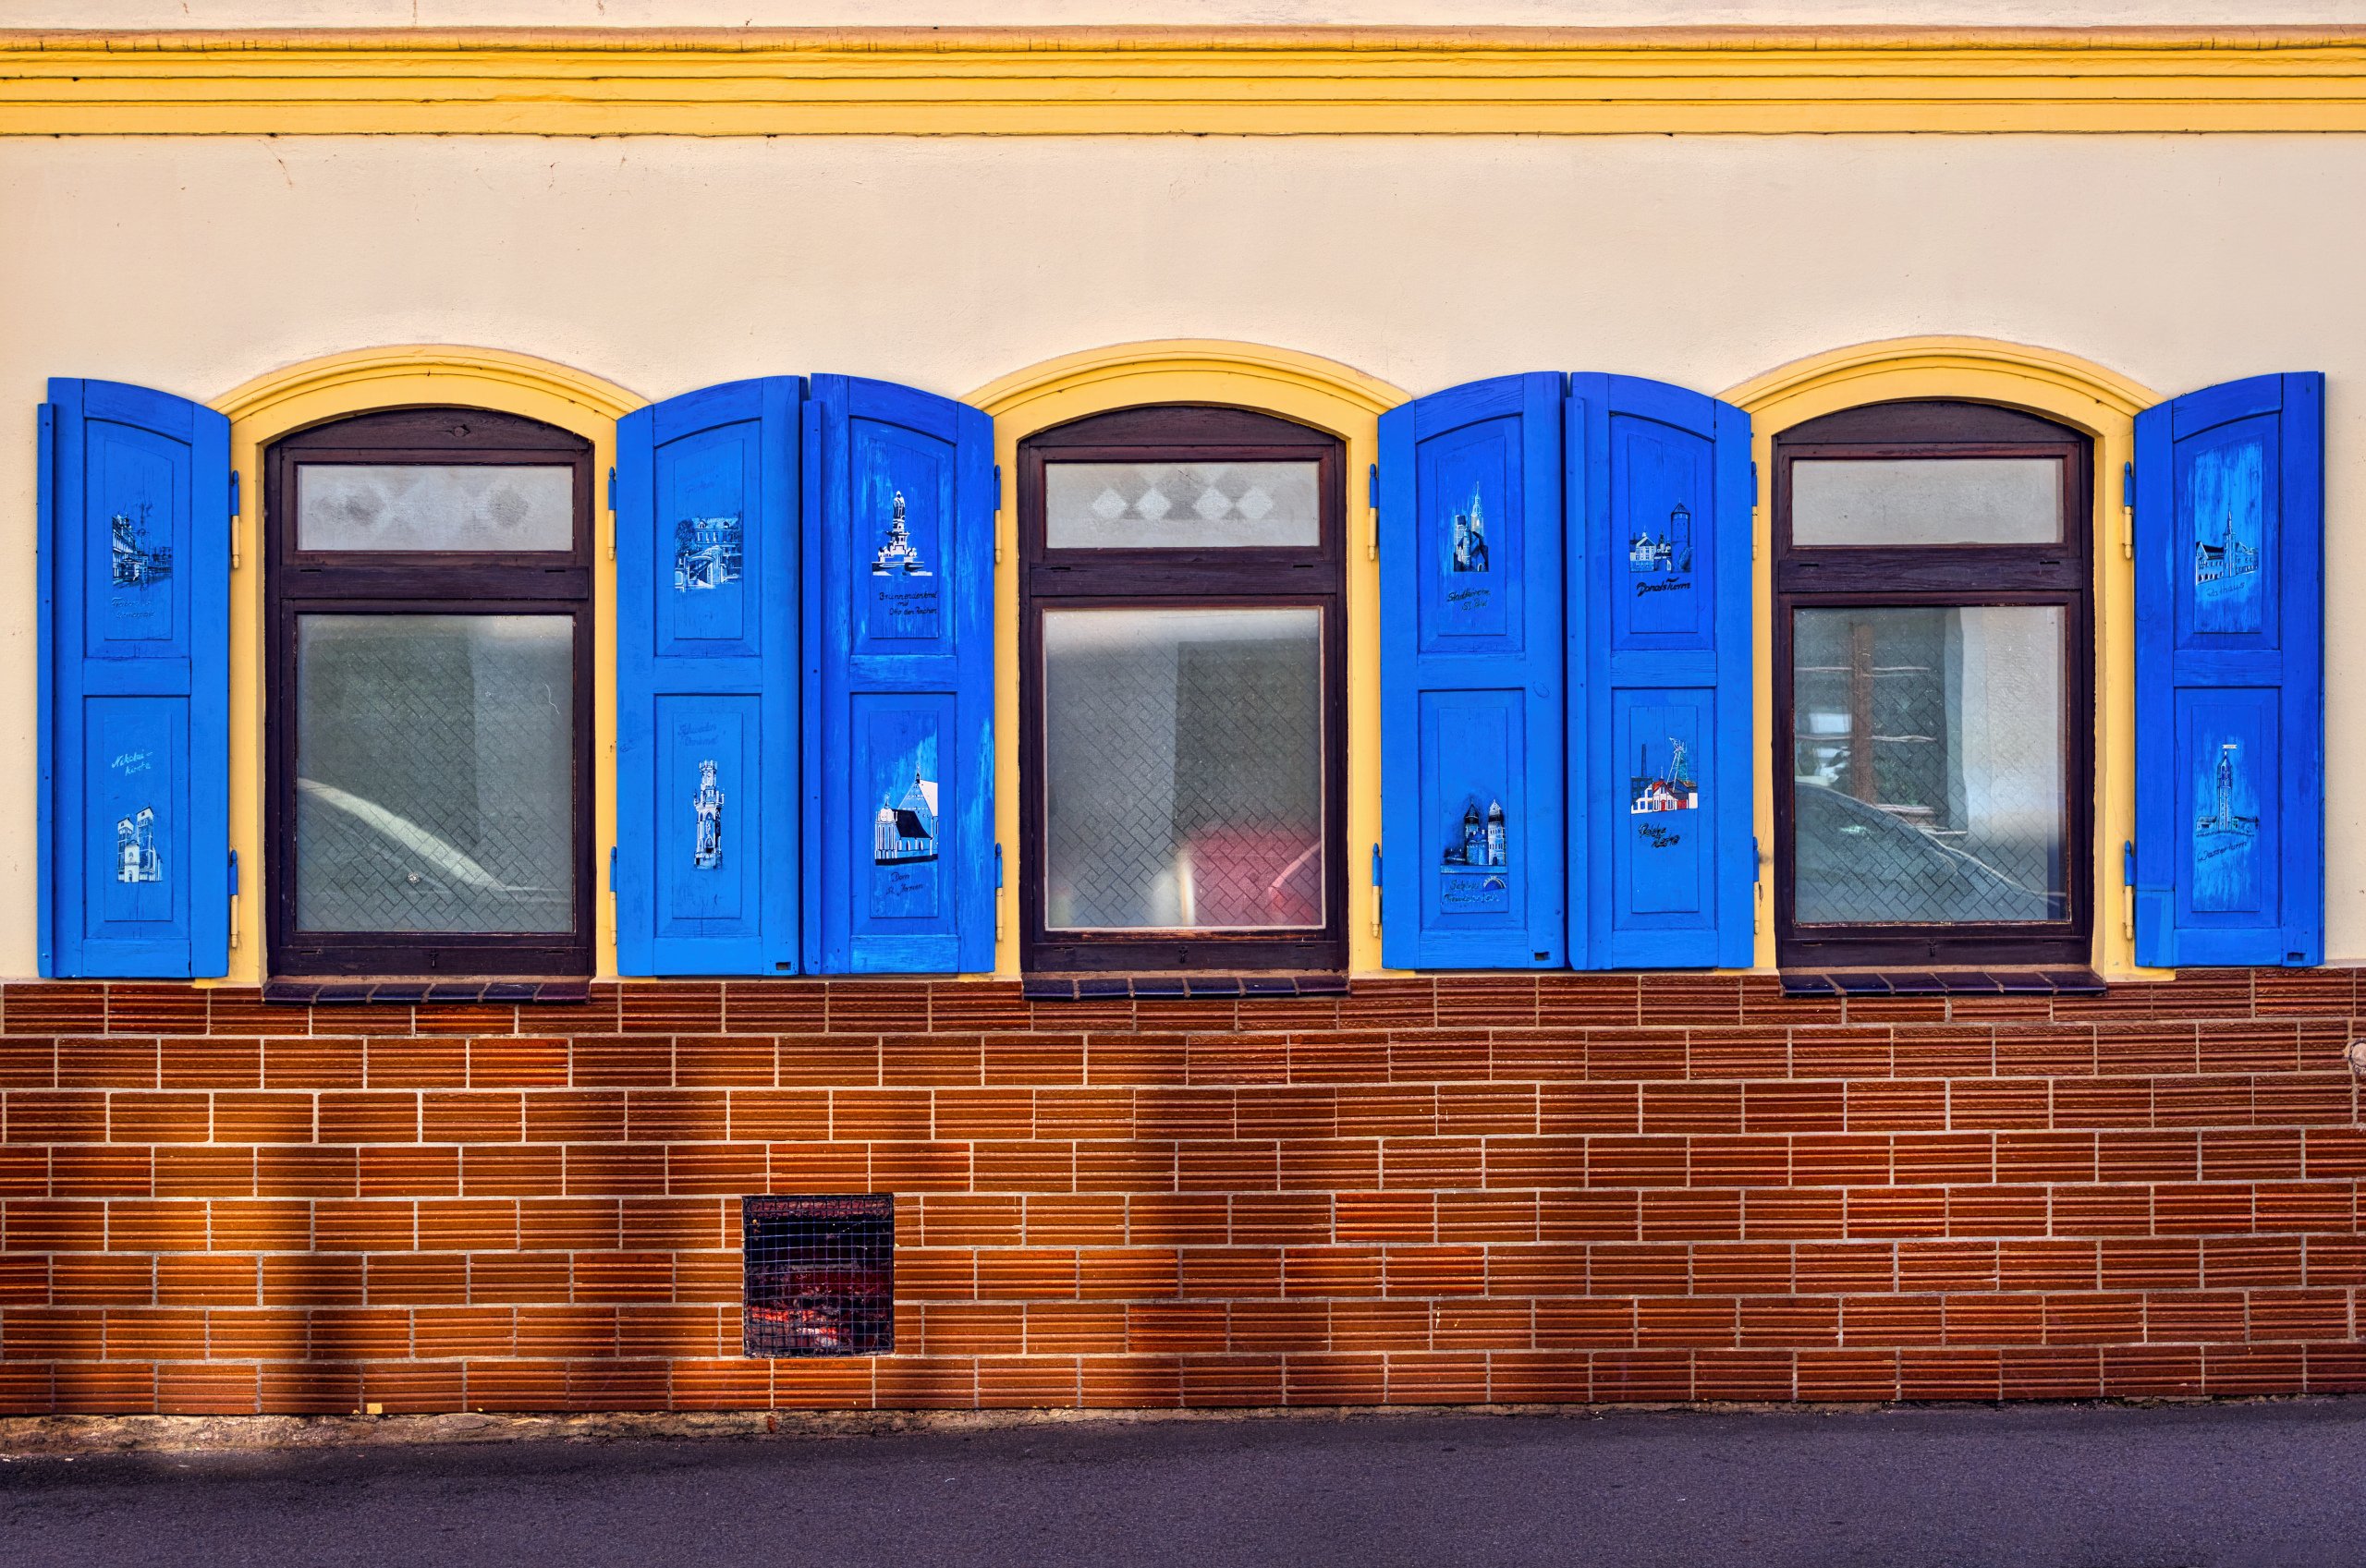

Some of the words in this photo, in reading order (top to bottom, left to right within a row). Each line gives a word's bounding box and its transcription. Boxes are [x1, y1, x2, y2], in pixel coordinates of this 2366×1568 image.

[2206, 582, 2245, 597] Rathaus
[889, 607, 902, 615] Otto
[891, 871, 910, 882] Dom
